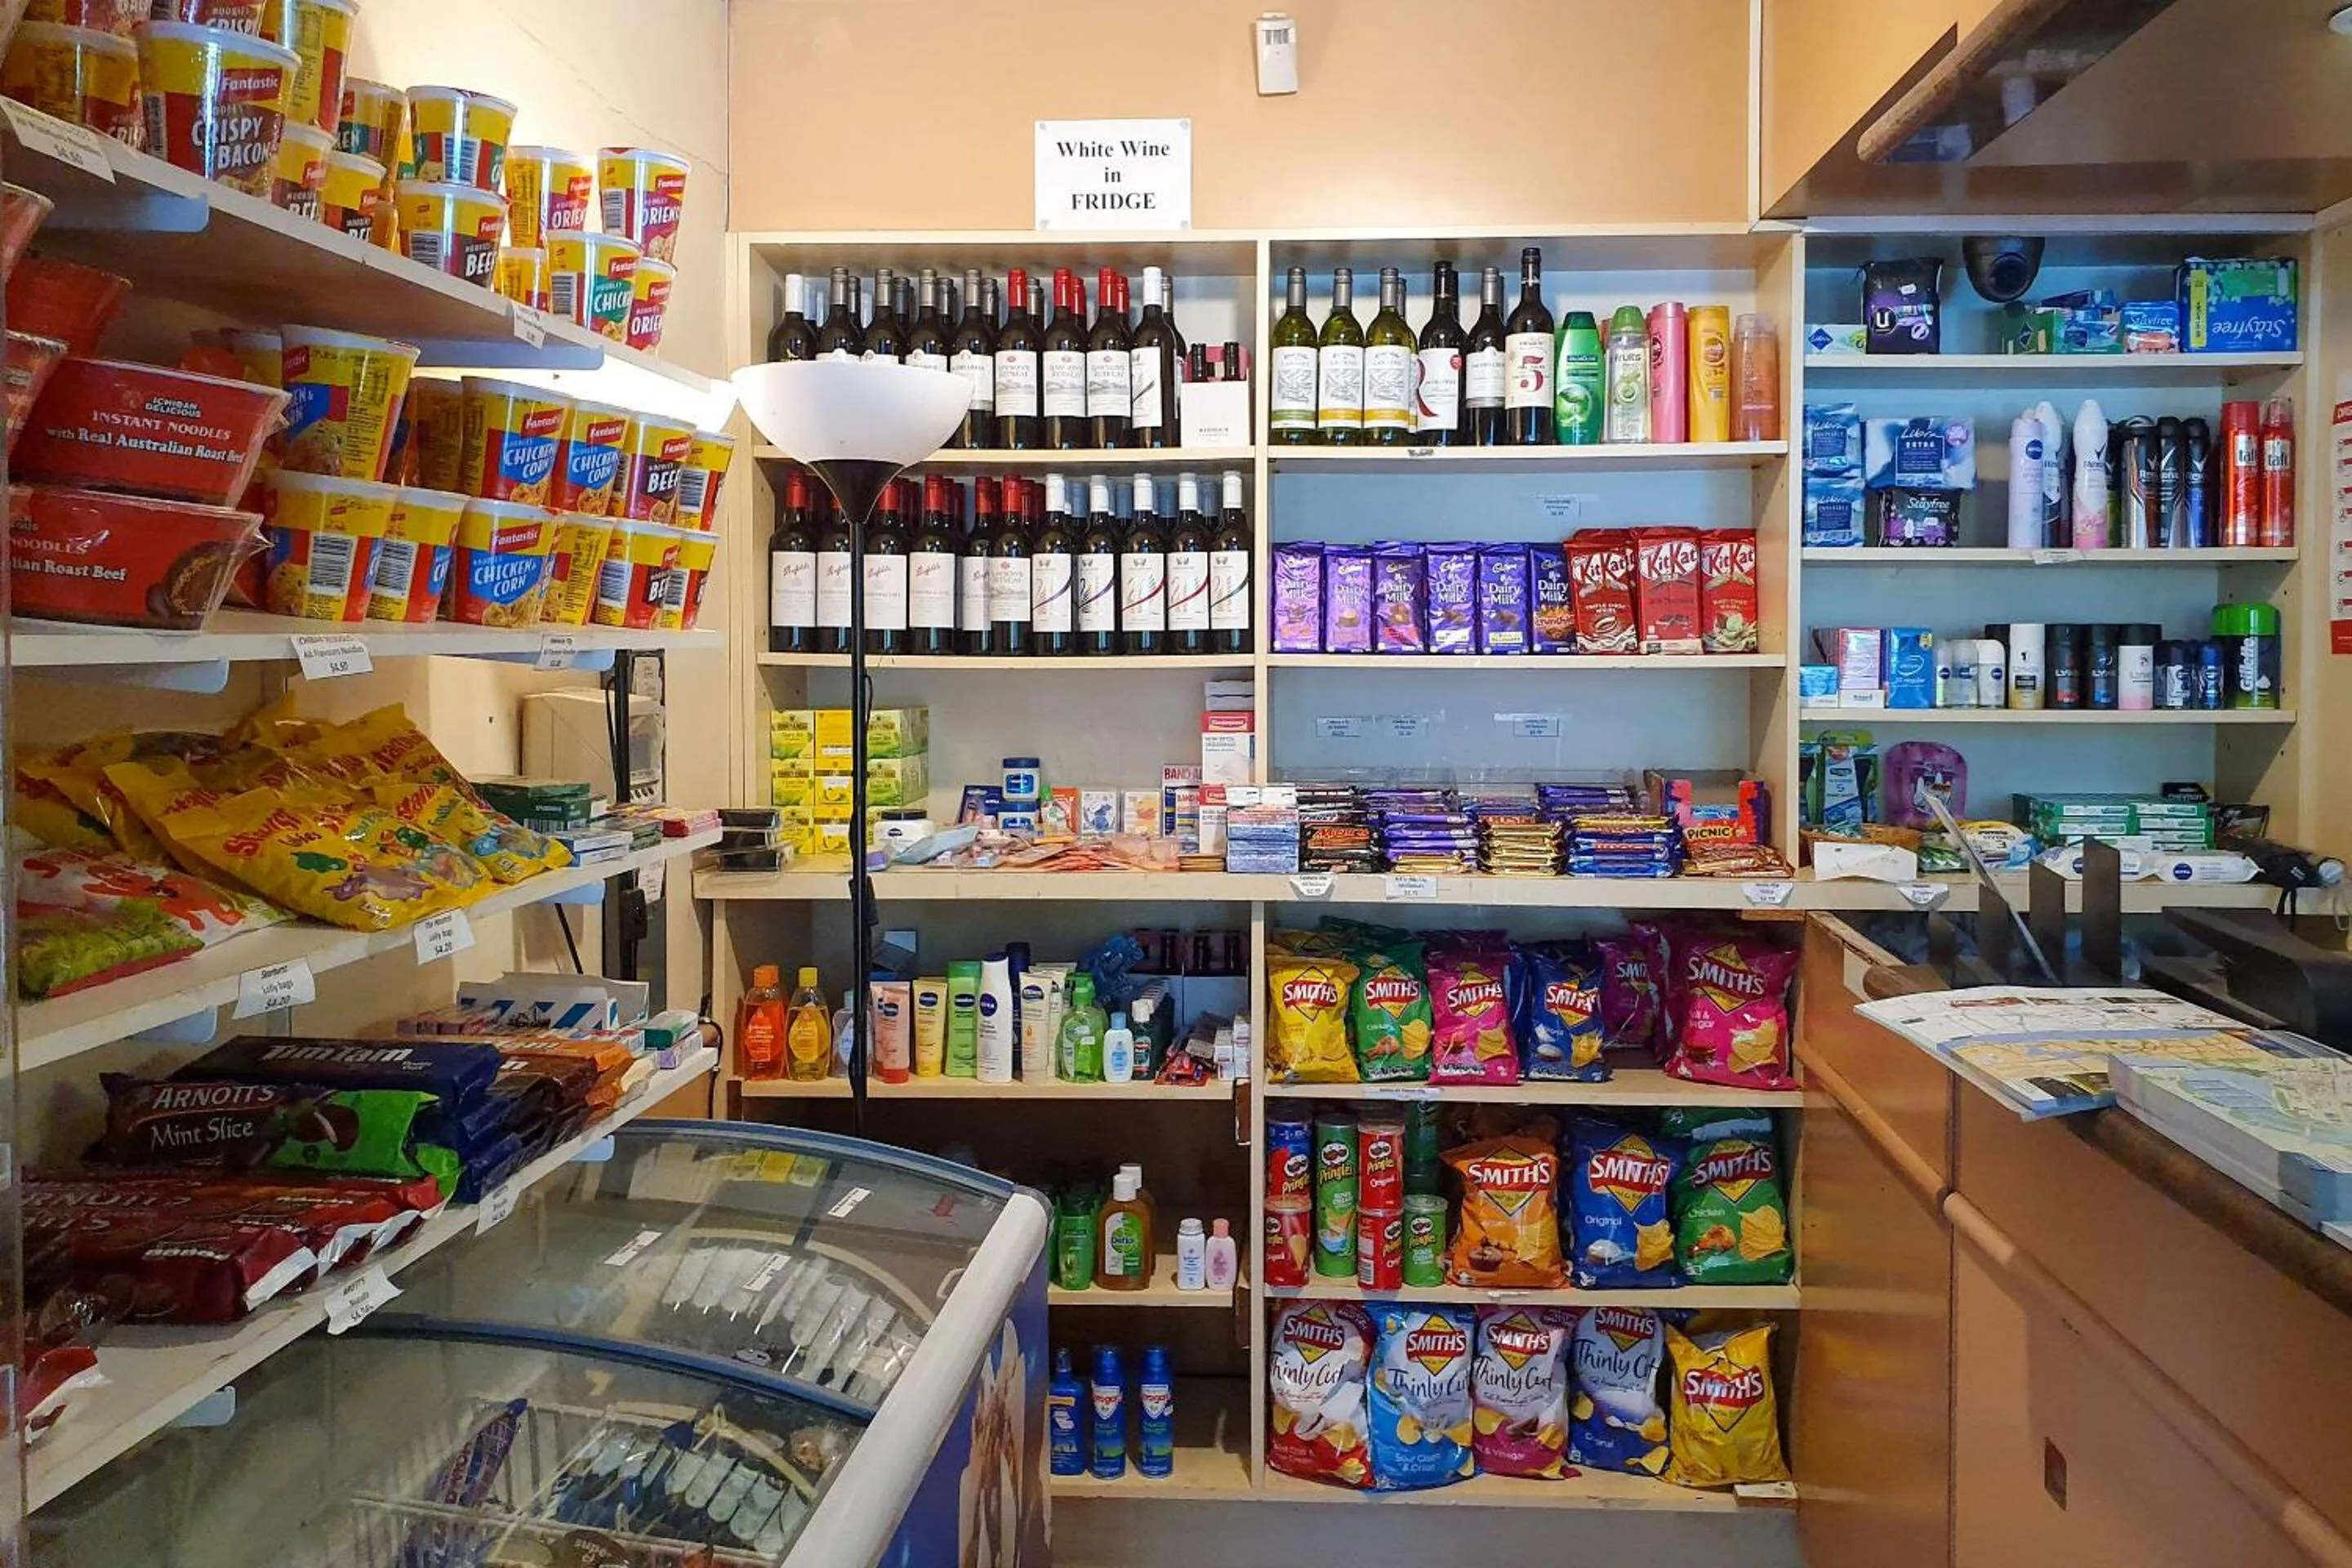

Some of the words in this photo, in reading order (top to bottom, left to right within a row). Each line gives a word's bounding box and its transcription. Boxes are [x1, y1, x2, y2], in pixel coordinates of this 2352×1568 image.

[221, 74, 279, 92] Fantastic
[217, 142, 271, 170] BACON
[1057, 140, 1114, 158] White
[1120, 140, 1170, 156] Wine
[1104, 167, 1121, 183] in
[1071, 192, 1156, 210] FRIDGE
[2212, 318, 2287, 341] Stayfree
[92, 410, 163, 431] INSTANT
[167, 420, 232, 441] NOODLES
[47, 427, 75, 440] with
[78, 427, 113, 446] Real
[115, 434, 194, 457] Australian
[195, 444, 227, 462] Roast
[492, 530, 539, 546] Fantastic
[44, 559, 89, 579] Roast
[91, 565, 127, 582] Beef
[474, 560, 532, 586] CHICKEN
[492, 574, 527, 599] CORN
[1489, 584, 1521, 599] Dairy
[1537, 579, 1570, 595] Dairy
[1538, 590, 1568, 603] Milk
[1489, 594, 1520, 605] Milk
[1686, 826, 1731, 840] PICNIC
[1283, 982, 1339, 1004] SMITH'S
[1365, 980, 1419, 1000] SMITH'S
[1446, 981, 1503, 1004] SMITH'S
[150, 1124, 203, 1152] Mint
[207, 1116, 255, 1143] Slice
[1468, 1157, 1551, 1186] SMITH'S
[1590, 1154, 1669, 1187] SMITH'S
[1694, 1149, 1773, 1186] SMITH'S
[1584, 1214, 1623, 1226] Original
[1285, 1316, 1344, 1346] SMITH'S
[1596, 1307, 1655, 1334] SMITH'S
[1407, 1333, 1467, 1352] SMITH'S
[1575, 1339, 1632, 1380] Thinly
[1270, 1352, 1316, 1391] Thinly
[1473, 1356, 1522, 1397] Thinly
[1388, 1368, 1444, 1398] Thinly
